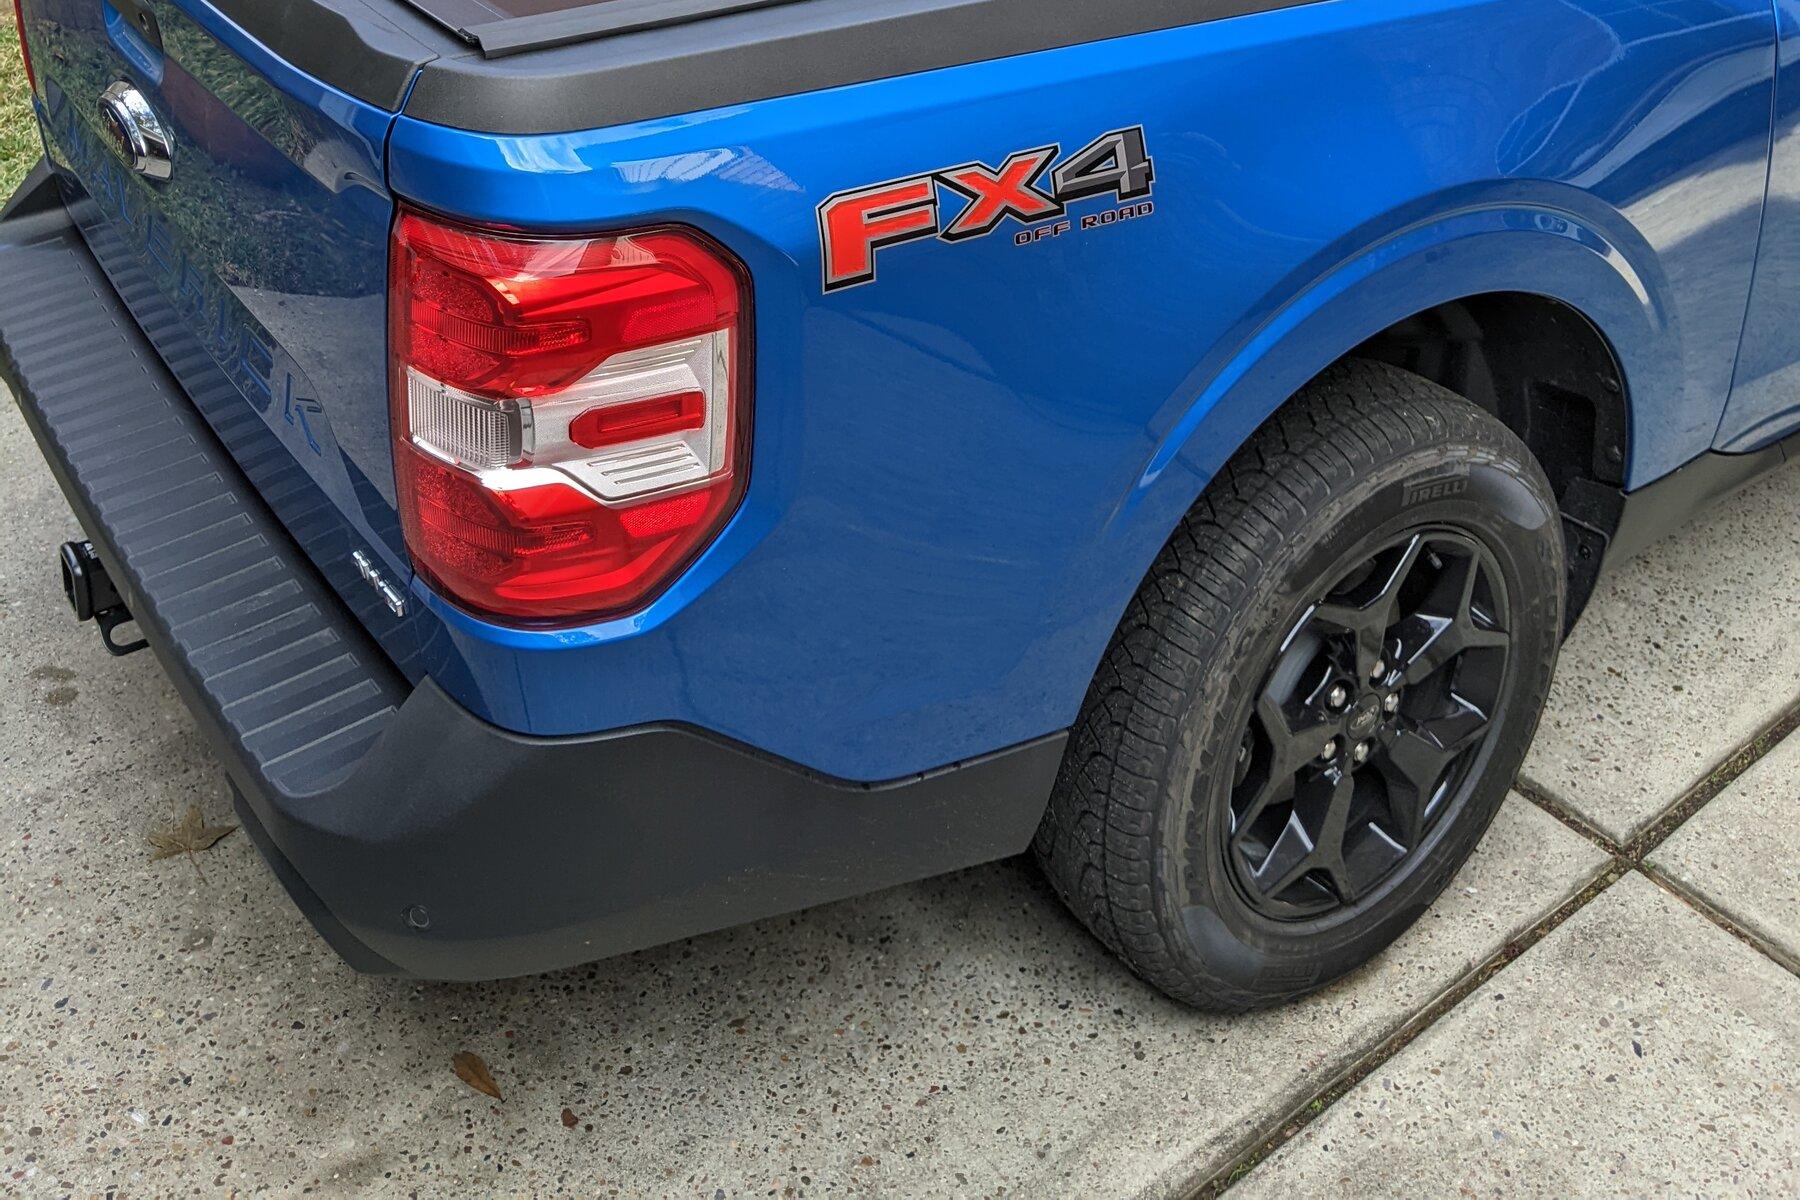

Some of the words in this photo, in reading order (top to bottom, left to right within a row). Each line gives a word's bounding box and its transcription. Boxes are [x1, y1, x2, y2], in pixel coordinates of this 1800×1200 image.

[815, 124, 1155, 294] FX4
[1014, 220, 1071, 246] OFF
[1080, 201, 1155, 230] ROAD
[1401, 476, 1469, 508] PIRELLI
